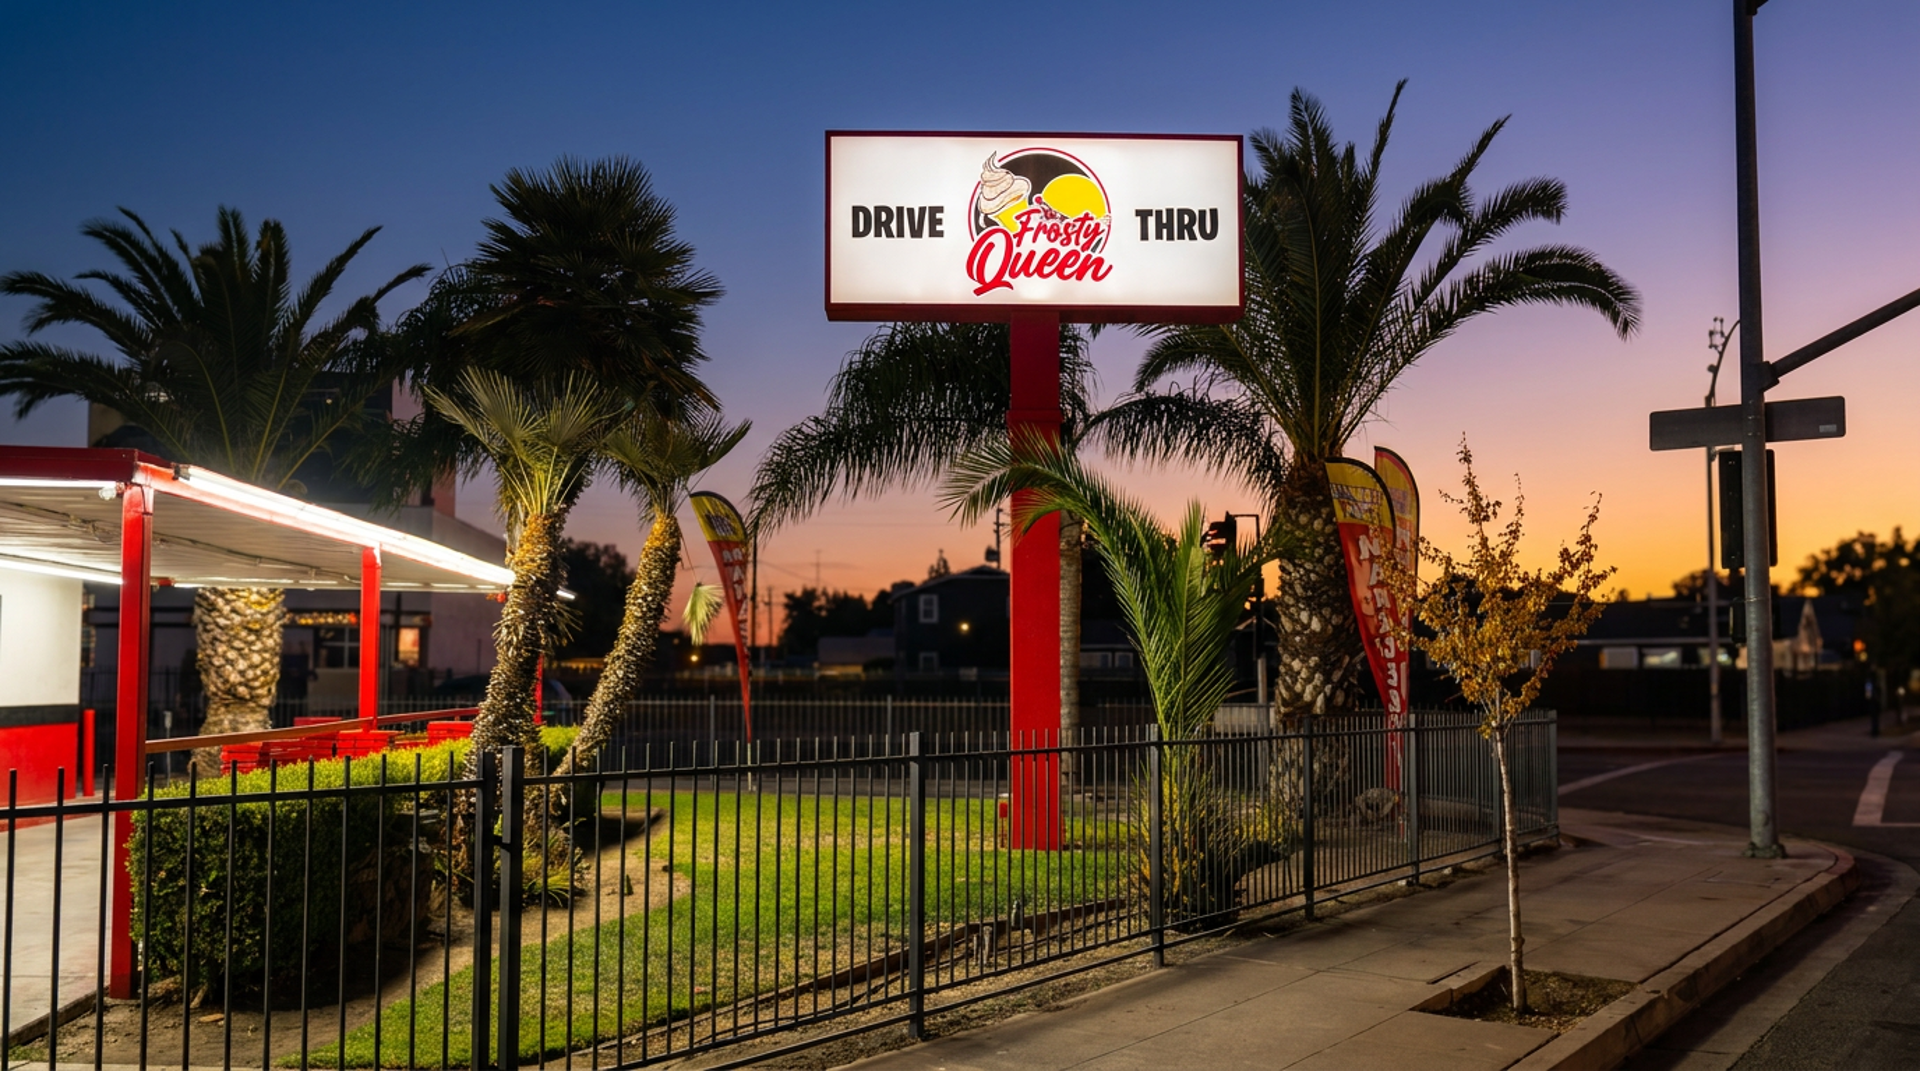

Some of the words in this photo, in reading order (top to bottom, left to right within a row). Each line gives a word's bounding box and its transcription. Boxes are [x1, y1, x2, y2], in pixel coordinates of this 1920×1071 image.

[851, 205, 945, 239] DRIVE
[1135, 208, 1219, 241] THRU
[1012, 208, 1101, 253] Frosty
[966, 227, 1113, 296] Queen
